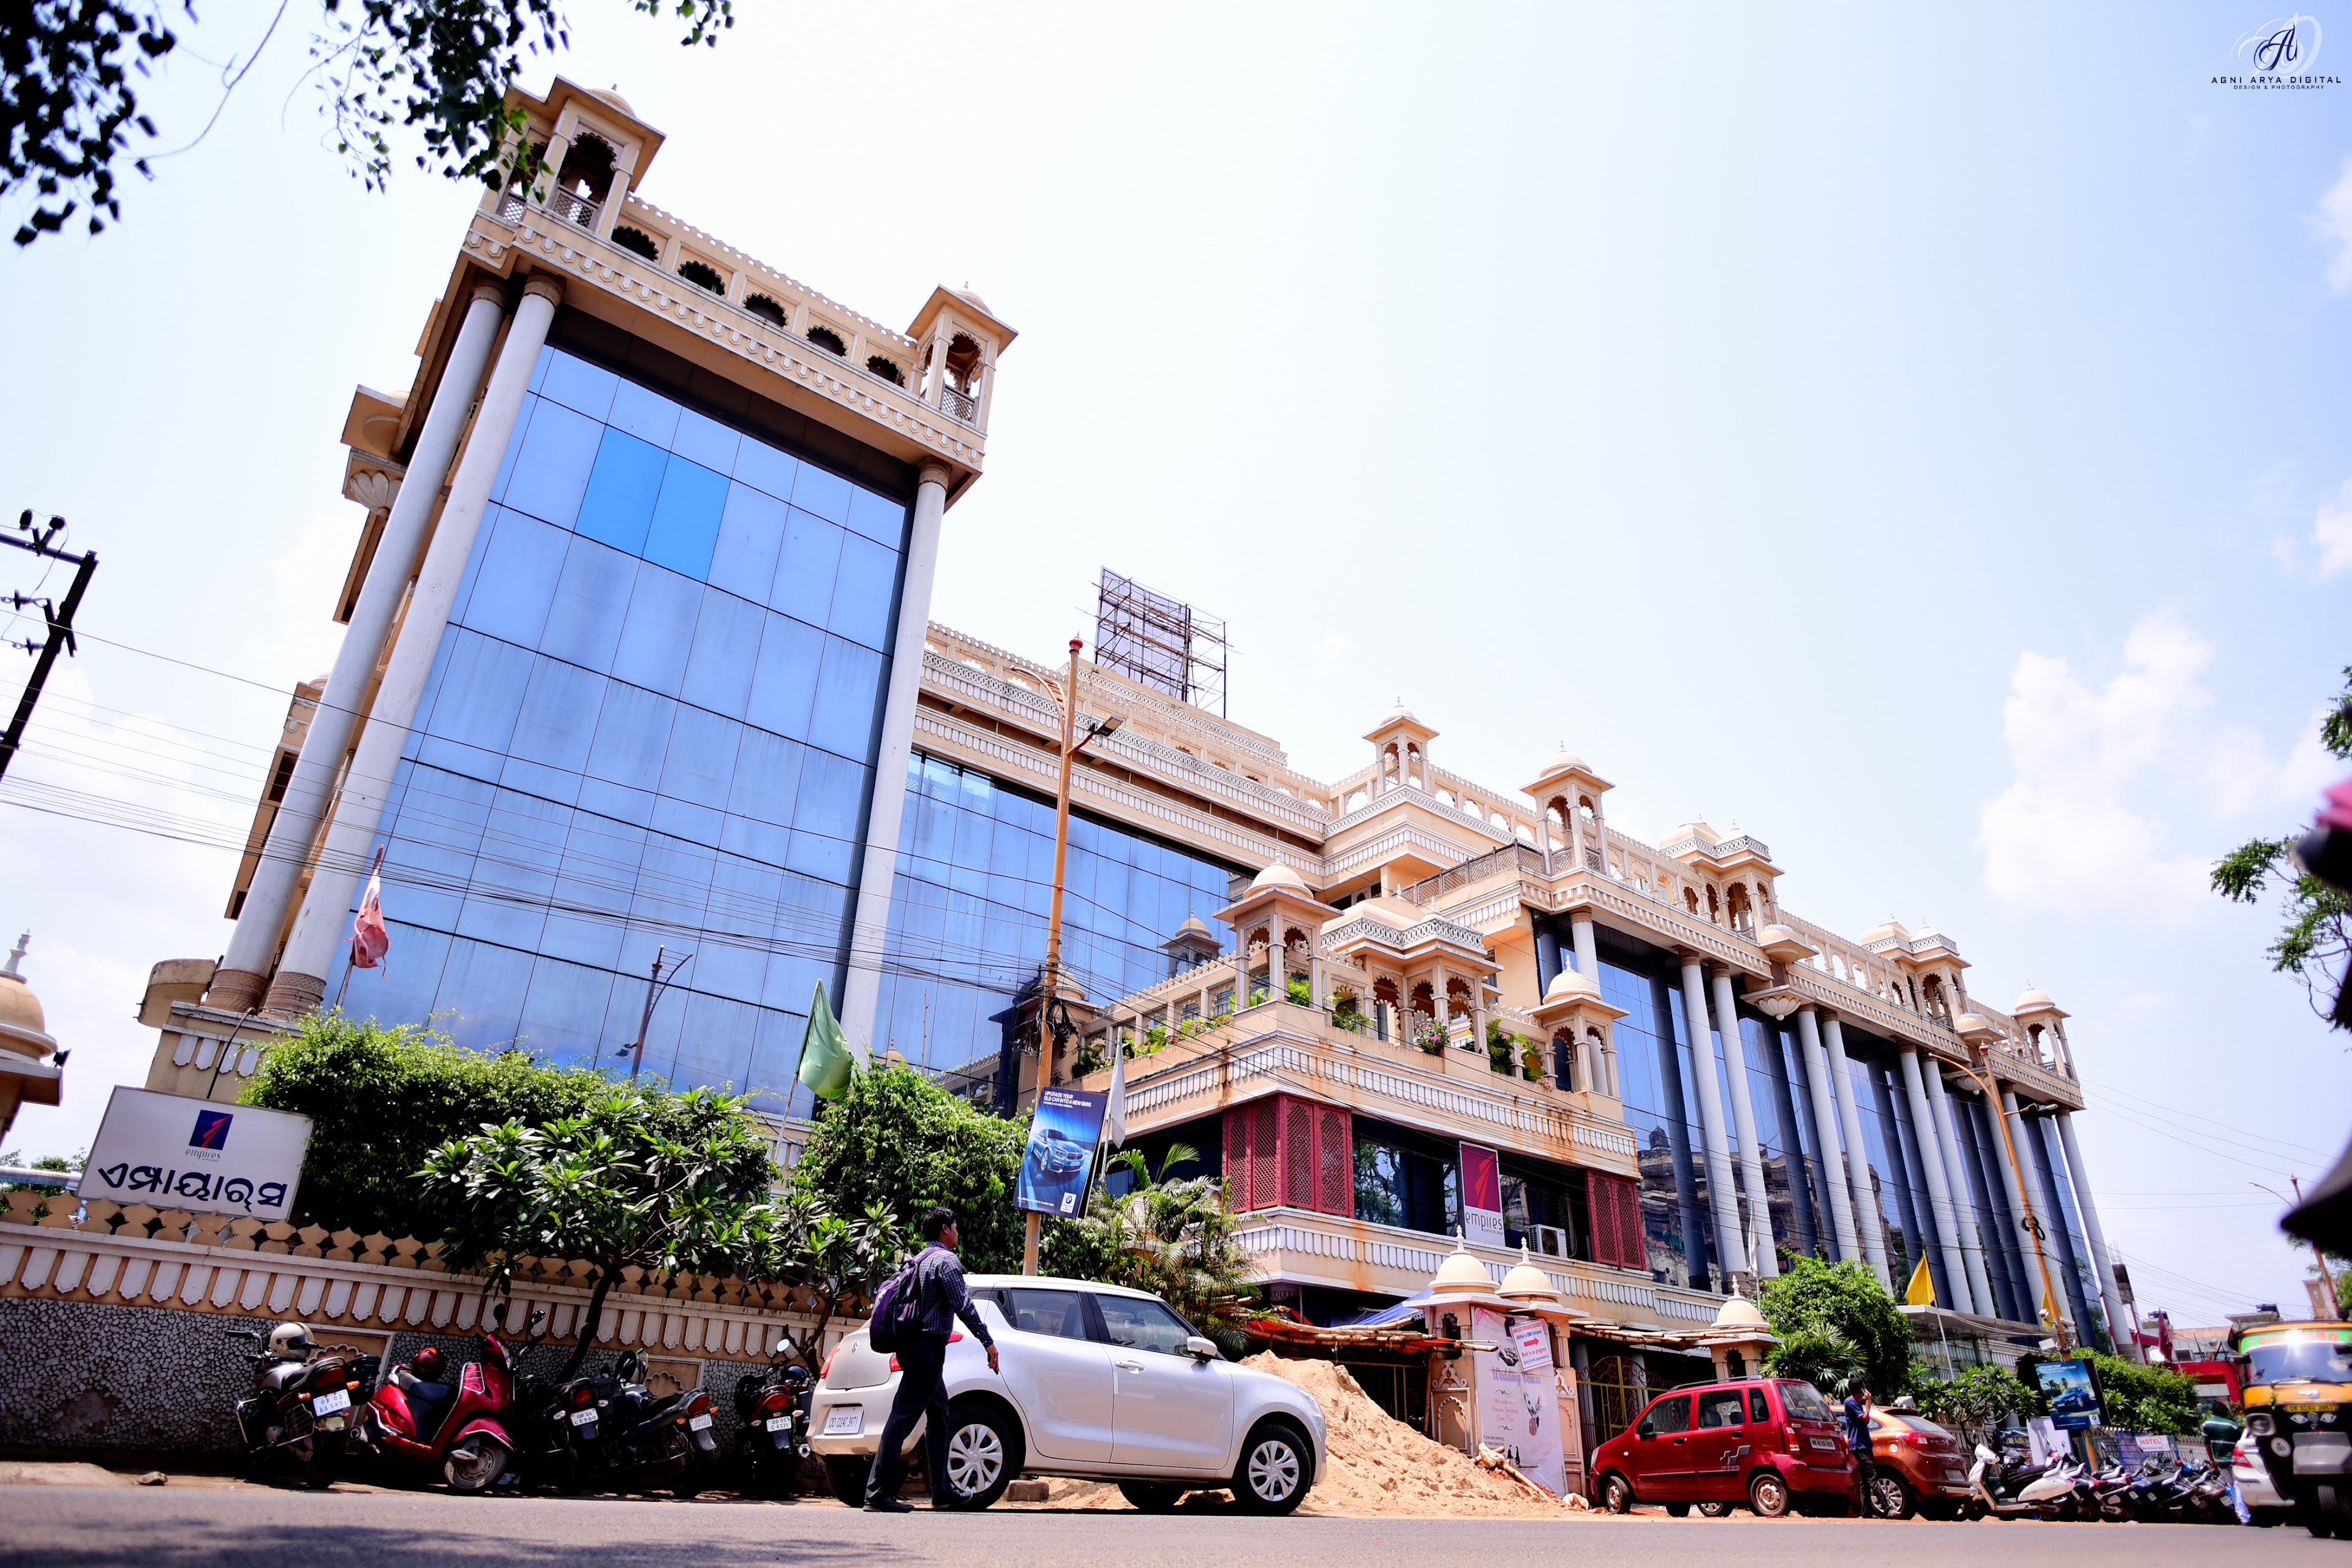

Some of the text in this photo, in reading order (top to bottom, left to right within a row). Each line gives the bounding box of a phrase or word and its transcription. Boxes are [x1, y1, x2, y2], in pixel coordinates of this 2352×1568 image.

[186, 1149, 221, 1159] empires
[1466, 1212, 1502, 1231] empires
[1491, 1367, 1521, 1386] Wedding
[829, 1417, 837, 1428] OD
[847, 1416, 858, 1427] 3971
